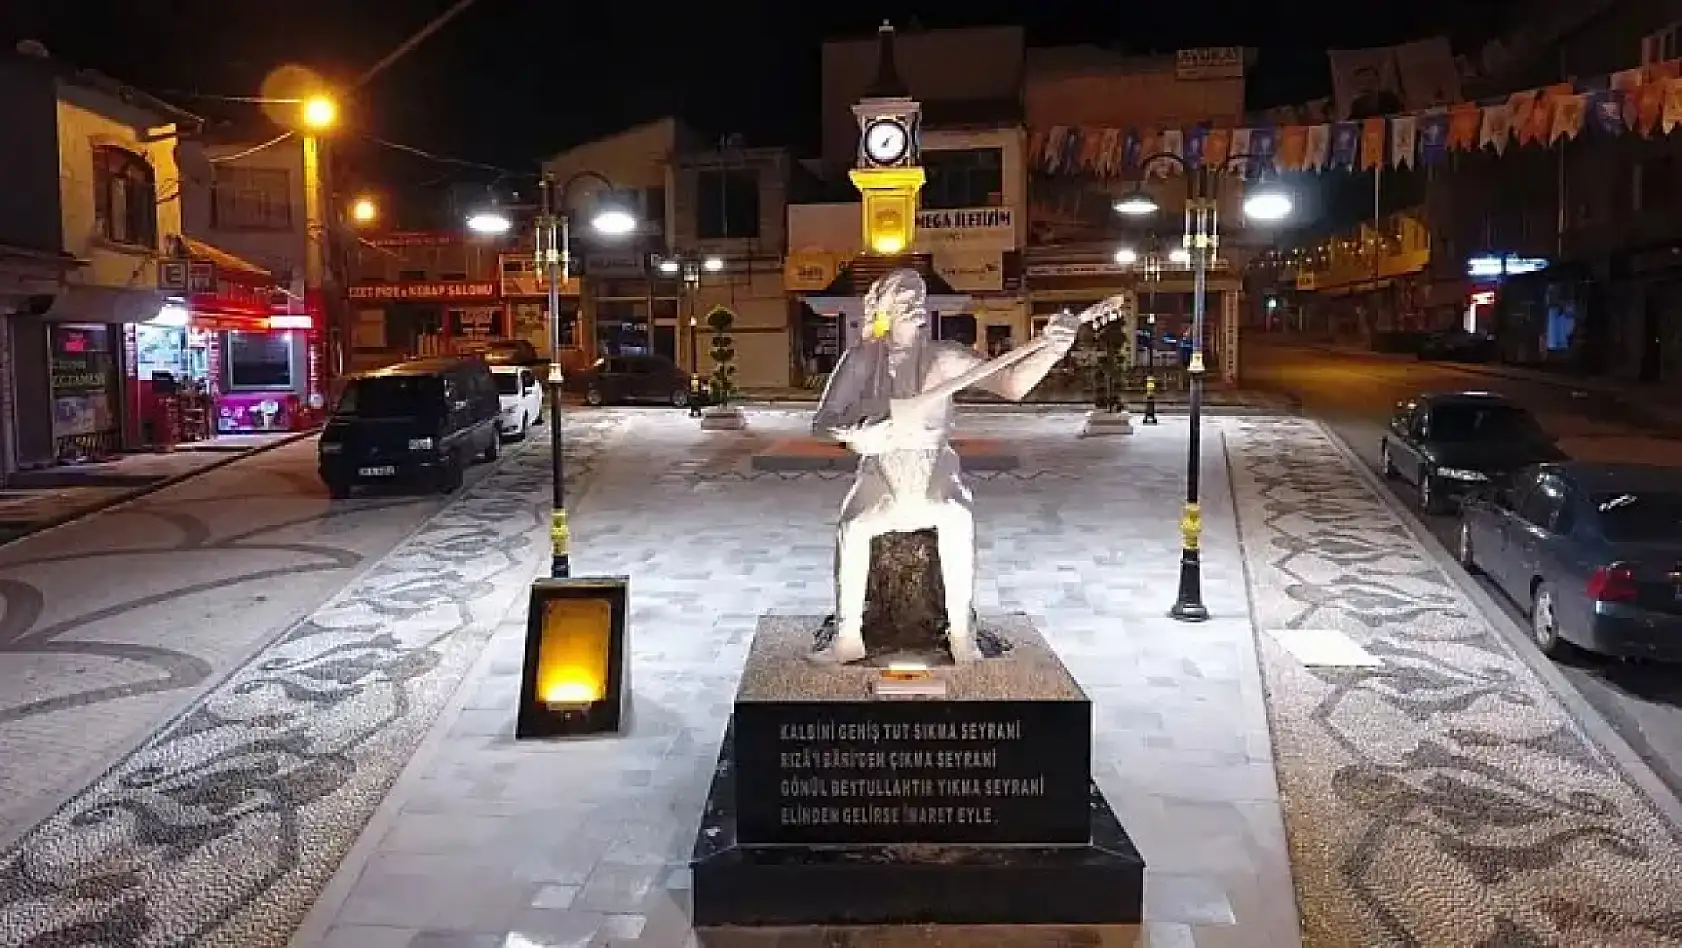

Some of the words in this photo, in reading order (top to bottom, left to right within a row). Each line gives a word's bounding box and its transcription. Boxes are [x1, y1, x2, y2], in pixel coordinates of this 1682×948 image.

[838, 720, 880, 744] GENİŞ
[882, 723, 910, 740] TUT
[914, 722, 956, 740] SIKMA
[889, 751, 933, 770] ÇIKMA
[780, 775, 828, 797] GÖNÜL
[938, 778, 981, 797] YIKMA
[780, 804, 840, 823] ELİNDEN
[842, 803, 900, 823] GELİRSE
